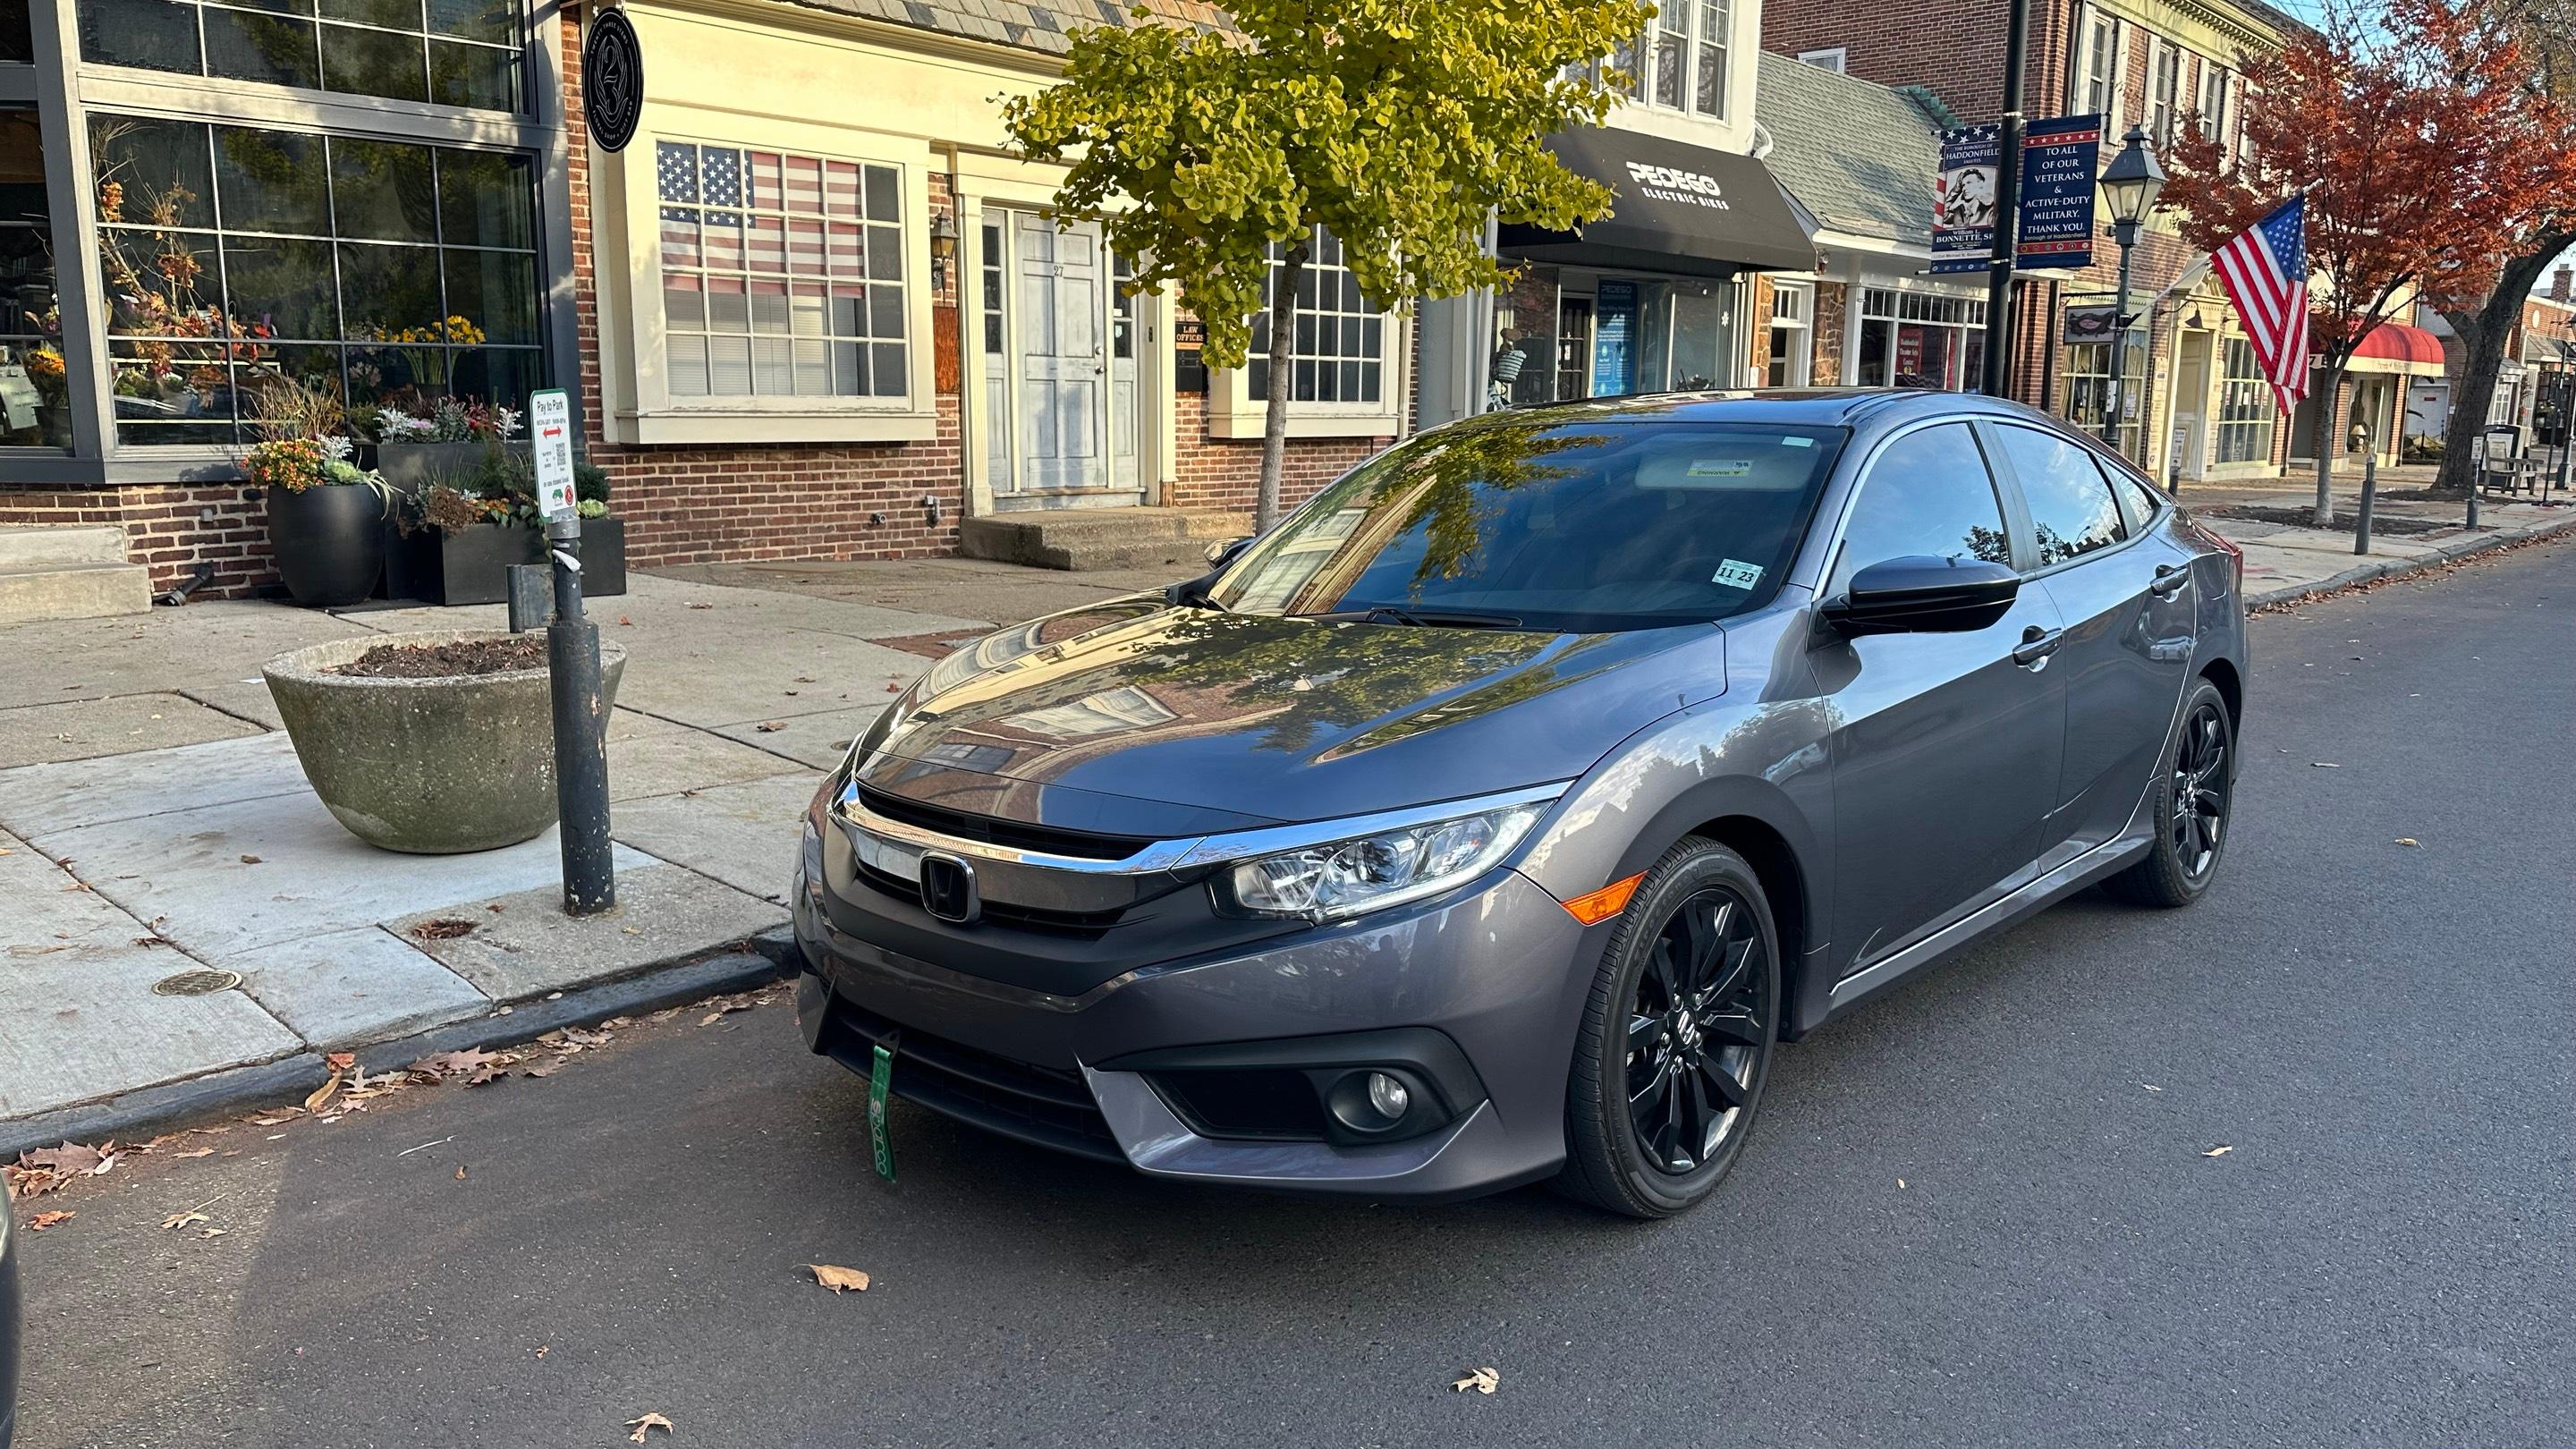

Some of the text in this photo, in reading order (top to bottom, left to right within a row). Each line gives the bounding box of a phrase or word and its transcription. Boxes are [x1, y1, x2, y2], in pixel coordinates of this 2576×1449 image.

[2046, 145, 2078, 156] TO ALL
[2041, 158, 2080, 170] OF OUR
[1625, 161, 1721, 197] PEDEGO
[2034, 171, 2085, 183] VETERANS
[2054, 185, 2063, 194] &
[1641, 187, 1730, 210] ELECTRIC BIKES
[2024, 195, 2090, 208] ACTIVE-DUTY
[2026, 224, 2061, 233] THANK
[1054, 265, 1063, 277] 27
[1182, 325, 1199, 334] LAW
[1176, 334, 1204, 342] OFFICES
[537, 399, 564, 415] Pay to Park
[1718, 567, 1754, 582] 11 23
